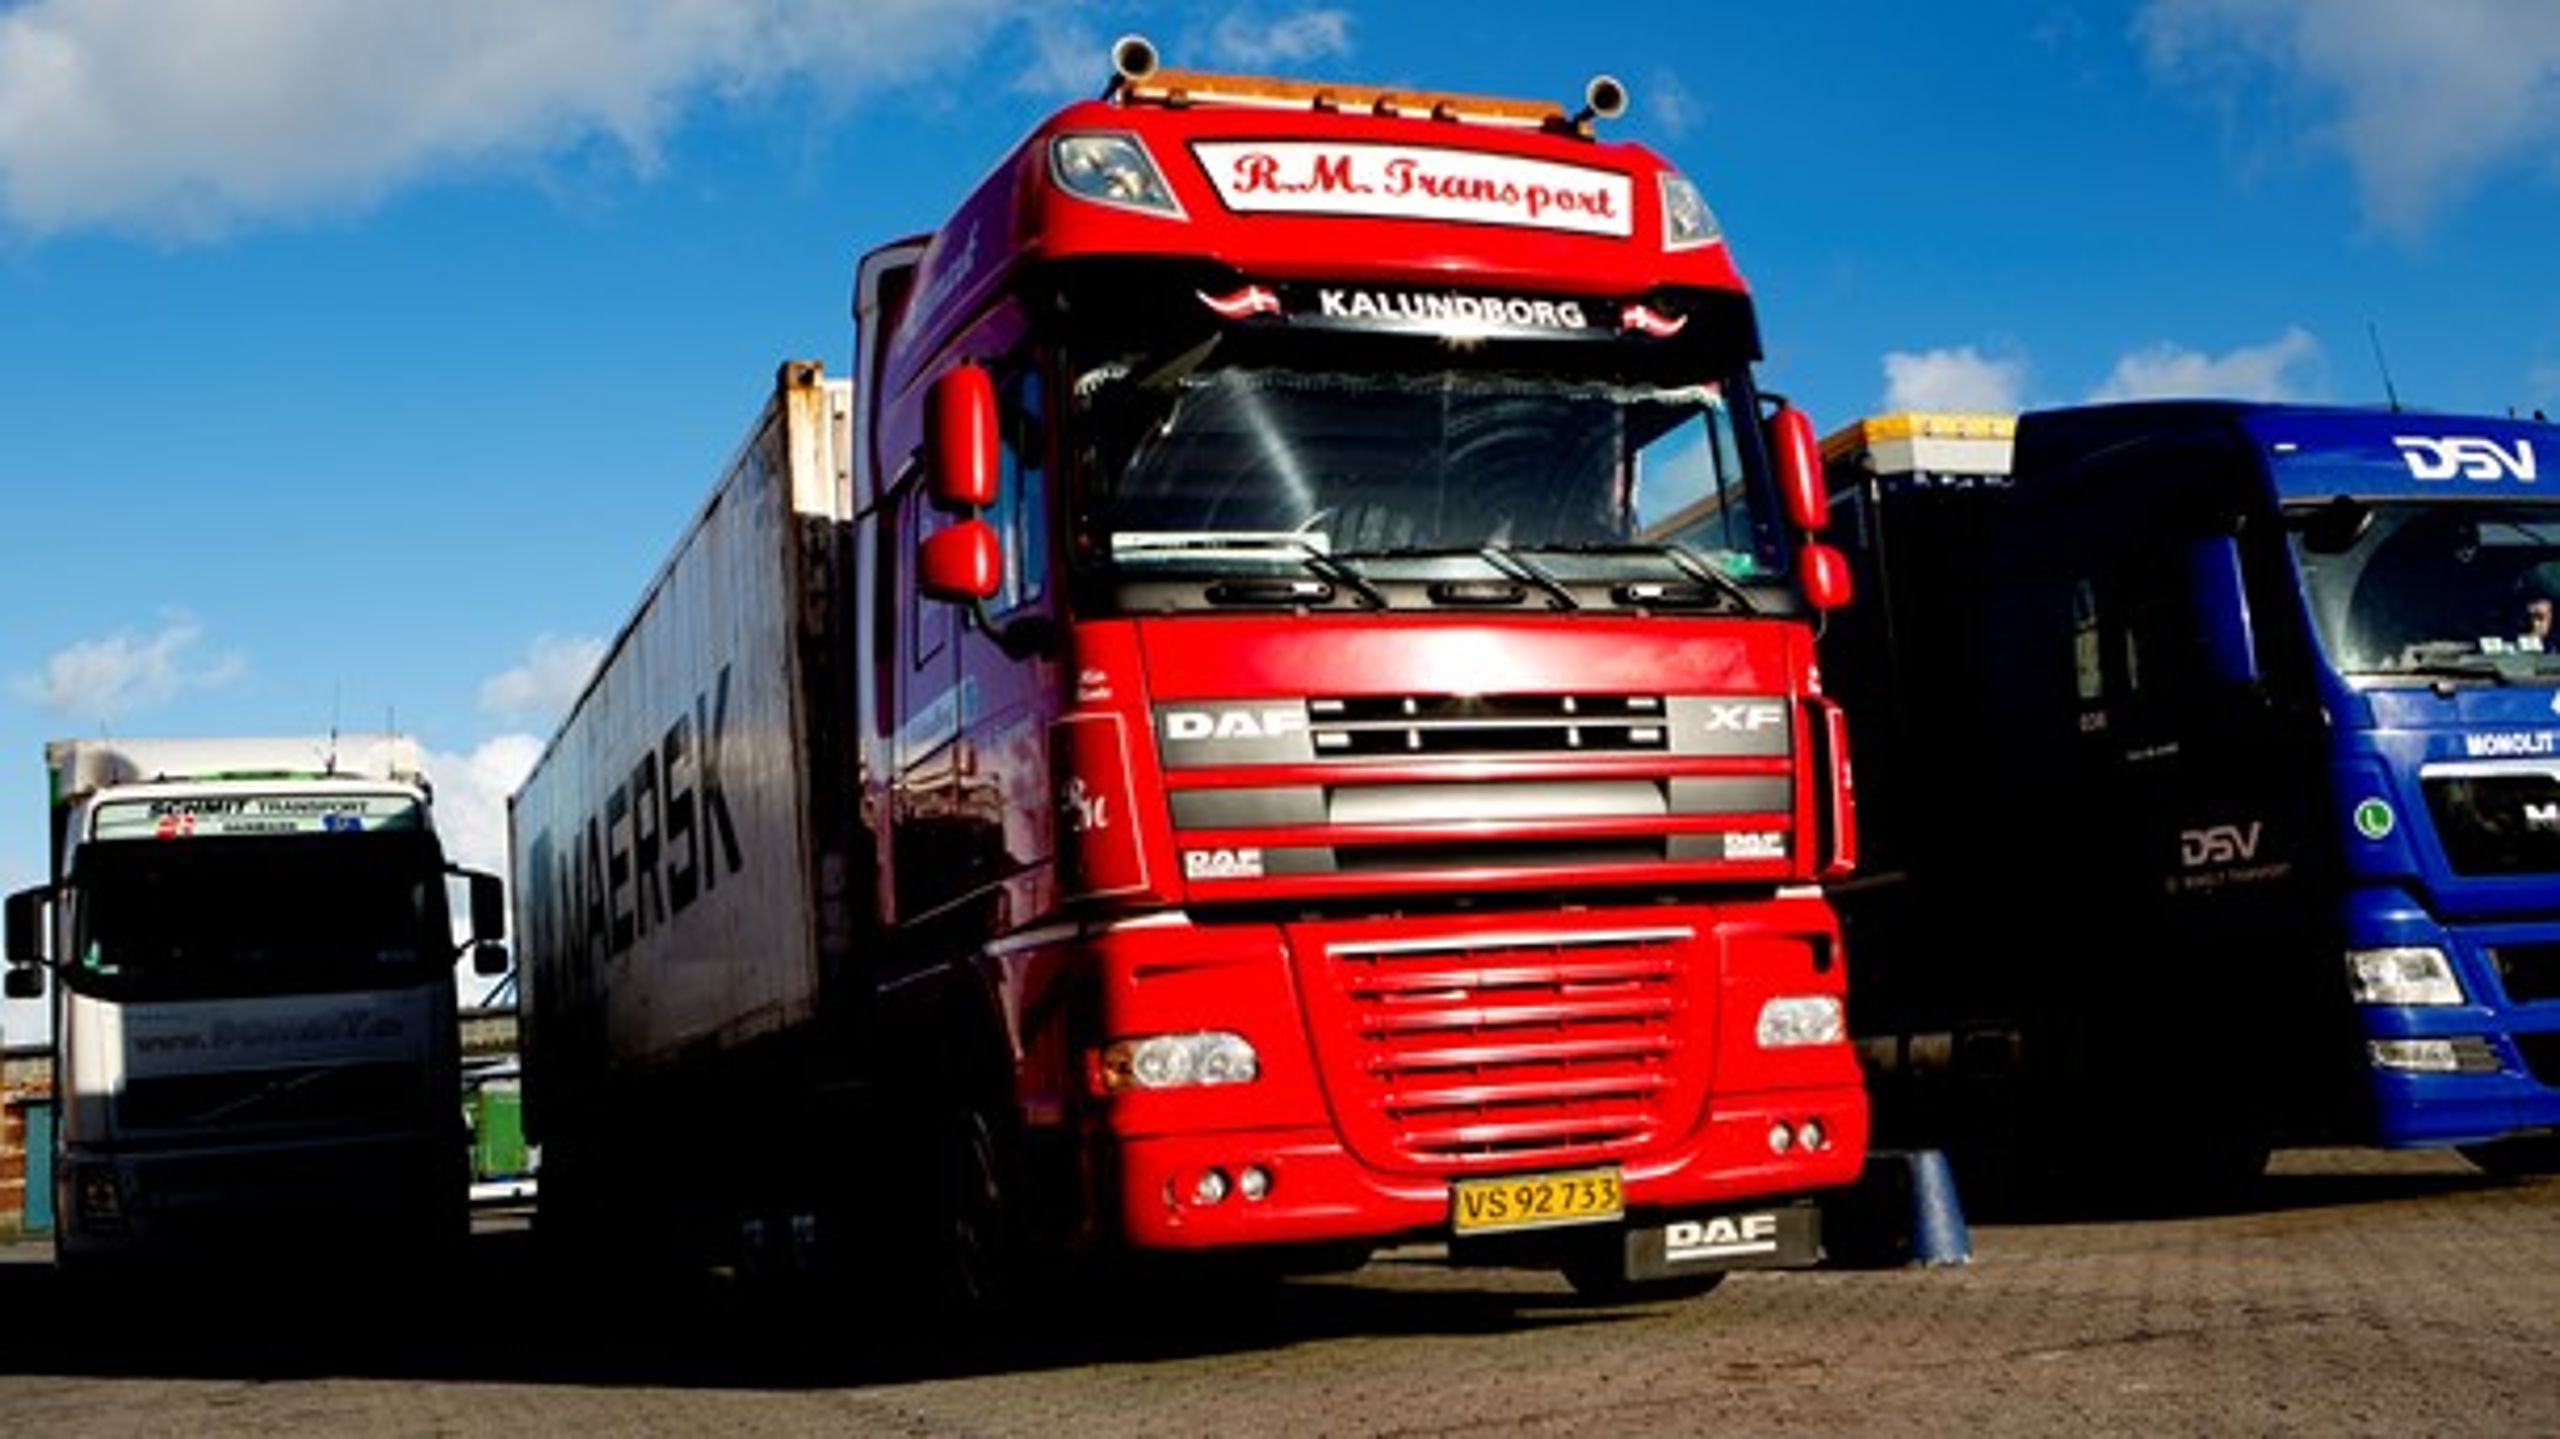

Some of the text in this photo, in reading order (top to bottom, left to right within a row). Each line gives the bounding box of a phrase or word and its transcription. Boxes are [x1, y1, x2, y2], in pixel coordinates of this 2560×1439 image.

[1384, 157, 1618, 219] Transport
[1318, 287, 1588, 330] KALUNDBORG
[2392, 435, 2536, 482] DSV
[1165, 711, 1307, 740] DAF
[1703, 704, 1784, 732] XF
[2466, 732, 2554, 756] MONOLIT
[147, 799, 370, 818] SCHMIT TRANSPORT
[2180, 820, 2262, 866] DSV
[1184, 849, 1263, 876] DAF
[1463, 1177, 1619, 1220] VS 92 733
[1665, 1214, 1777, 1250] DAF
